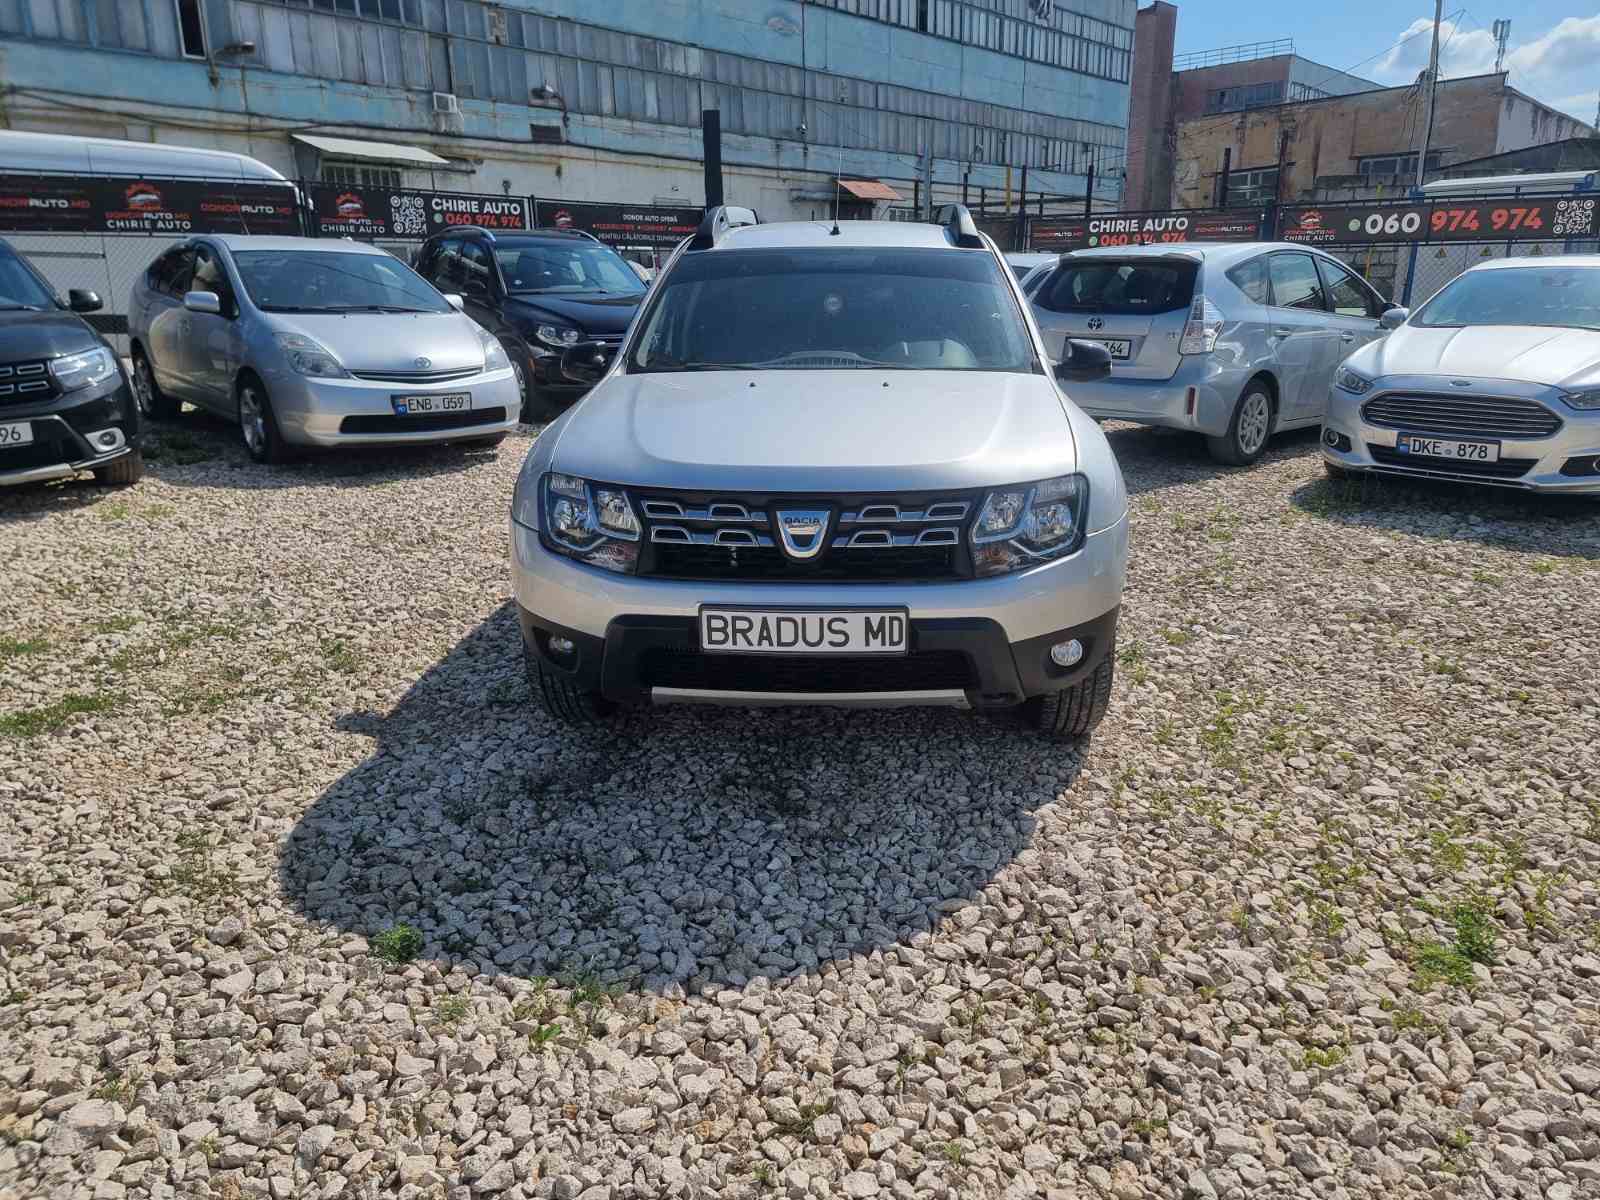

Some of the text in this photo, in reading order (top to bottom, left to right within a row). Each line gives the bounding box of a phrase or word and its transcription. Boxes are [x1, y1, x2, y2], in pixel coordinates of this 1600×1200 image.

[431, 198, 521, 215] CHIRIE AUTO
[106, 220, 191, 230] CHIRIE AUTO
[445, 213, 522, 227] 060 974 974
[1089, 217, 1189, 233] CHIRIE AUTO
[1364, 207, 1543, 235] 060 974 974
[321, 224, 385, 234] CHIRIE AUTO
[1101, 234, 1128, 246] 060
[407, 397, 464, 411] ENB 059
[0, 426, 21, 442] 96
[1411, 439, 1488, 459] DKE 878
[784, 516, 821, 524] DACIA
[706, 615, 904, 648] BRADUS MD
